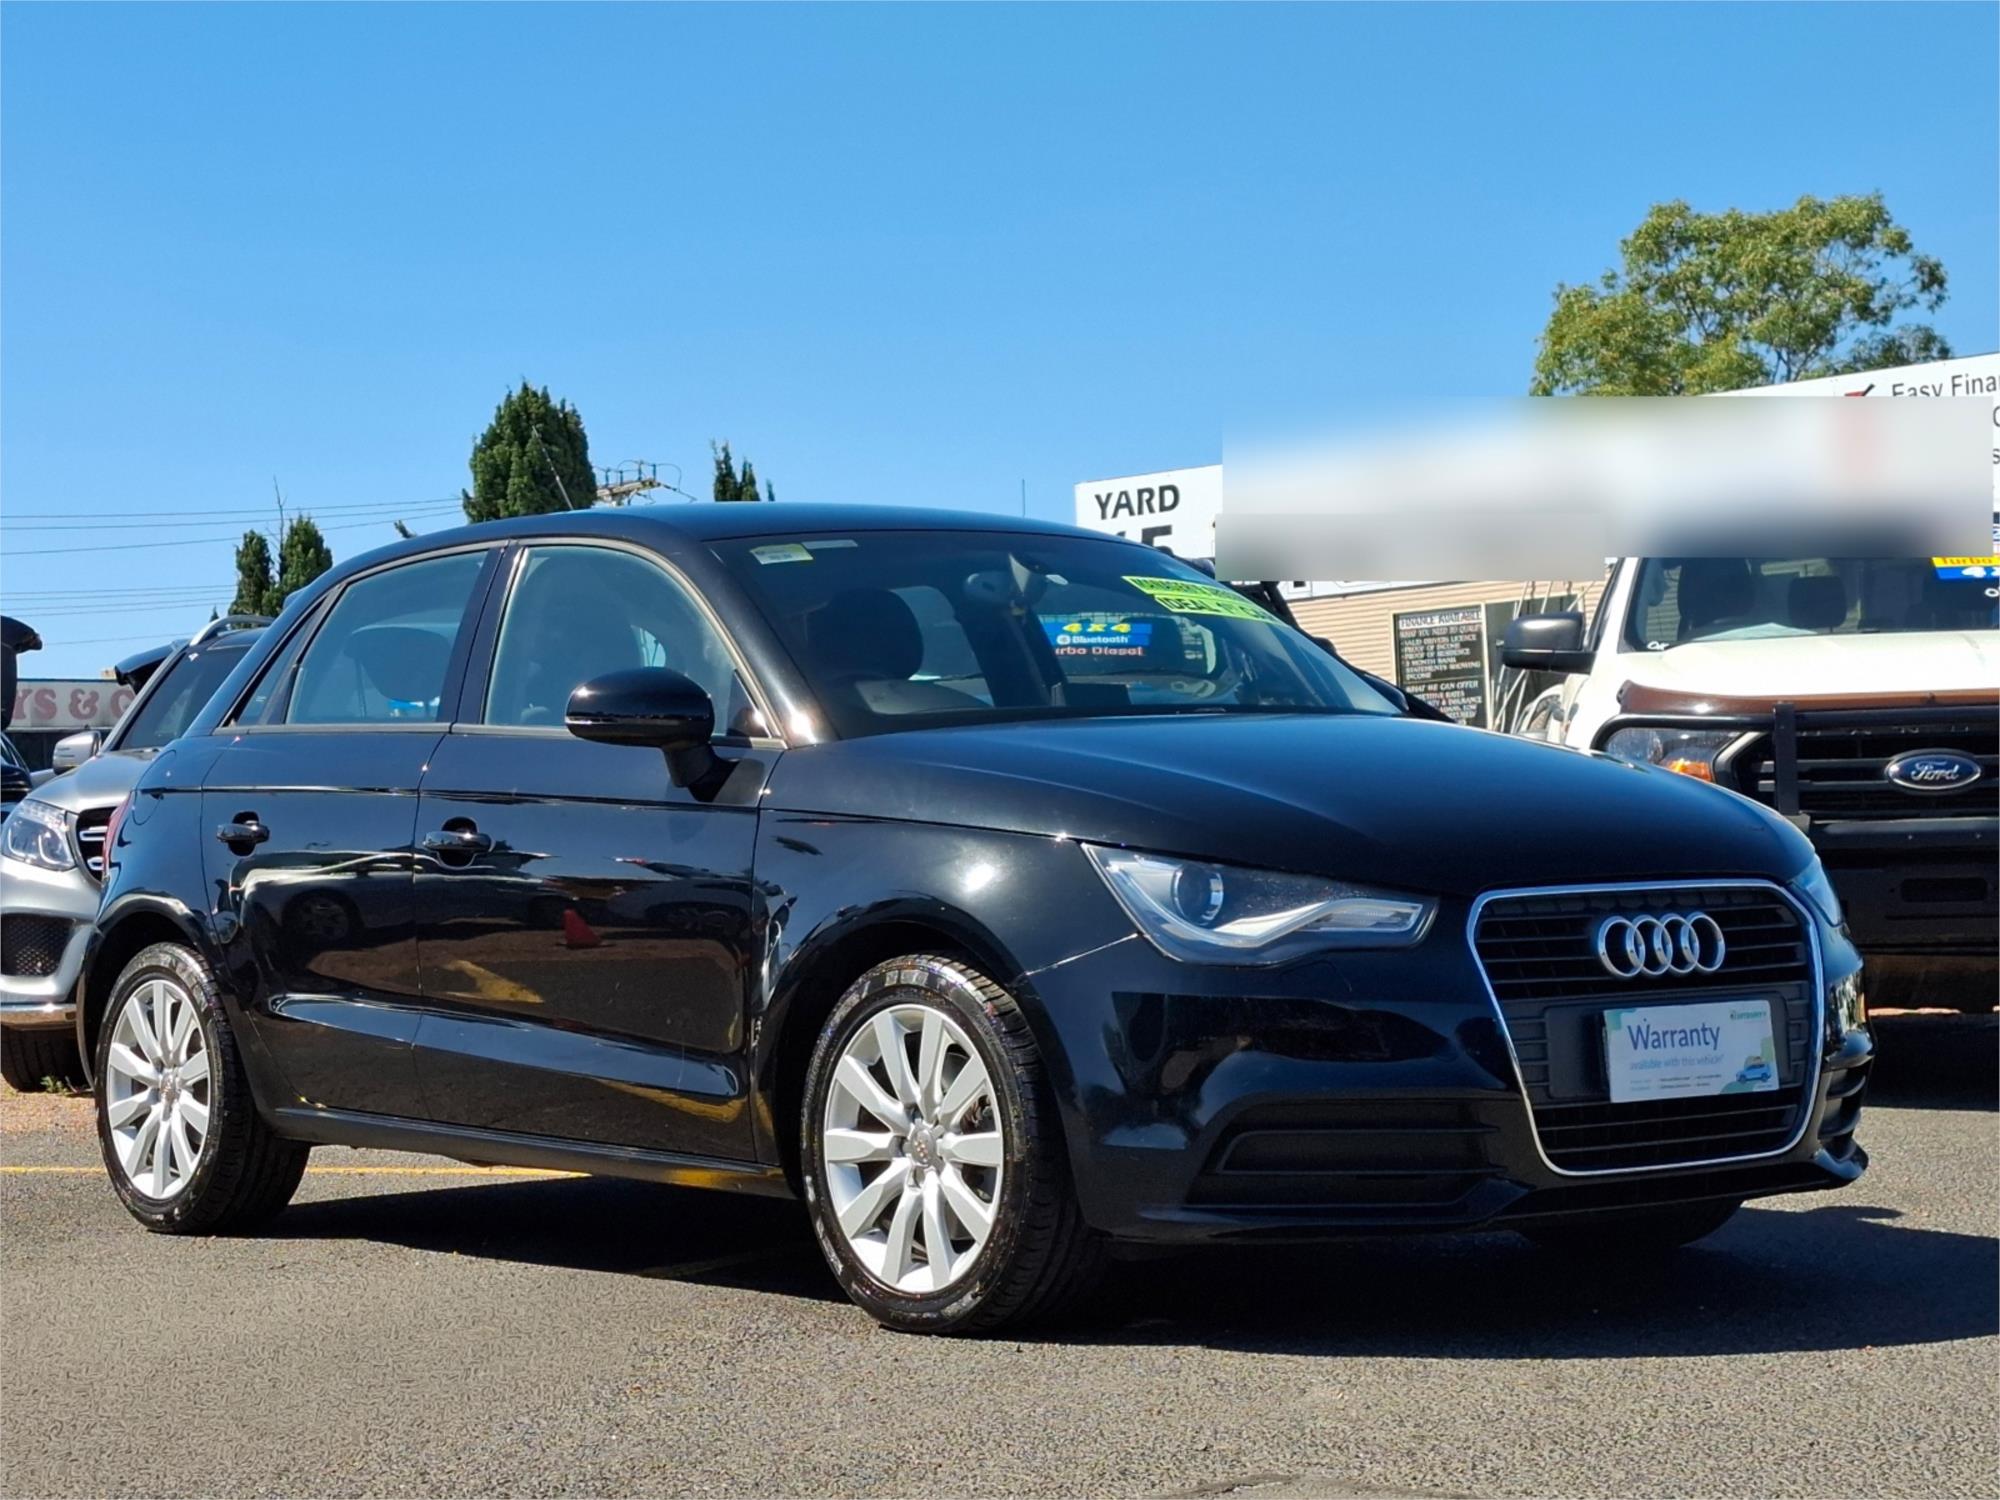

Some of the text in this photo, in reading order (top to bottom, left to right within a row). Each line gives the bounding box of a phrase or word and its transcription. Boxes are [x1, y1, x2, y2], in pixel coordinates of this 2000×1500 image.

[1951, 373, 2000, 397] Fina
[1094, 484, 1180, 520] YARD
[1157, 596, 1220, 613] IDEAL
[1400, 615, 1434, 628] FINANCE
[1072, 635, 1129, 645] Bluetooth
[1055, 646, 1144, 656] rbo Diesel
[1440, 682, 1455, 690] CAN
[1456, 680, 1479, 689] OFFER
[68, 688, 99, 720] &
[1911, 760, 1960, 781] Ford
[1627, 1022, 1720, 1051] Warranty
[1664, 1056, 1679, 1067] with
